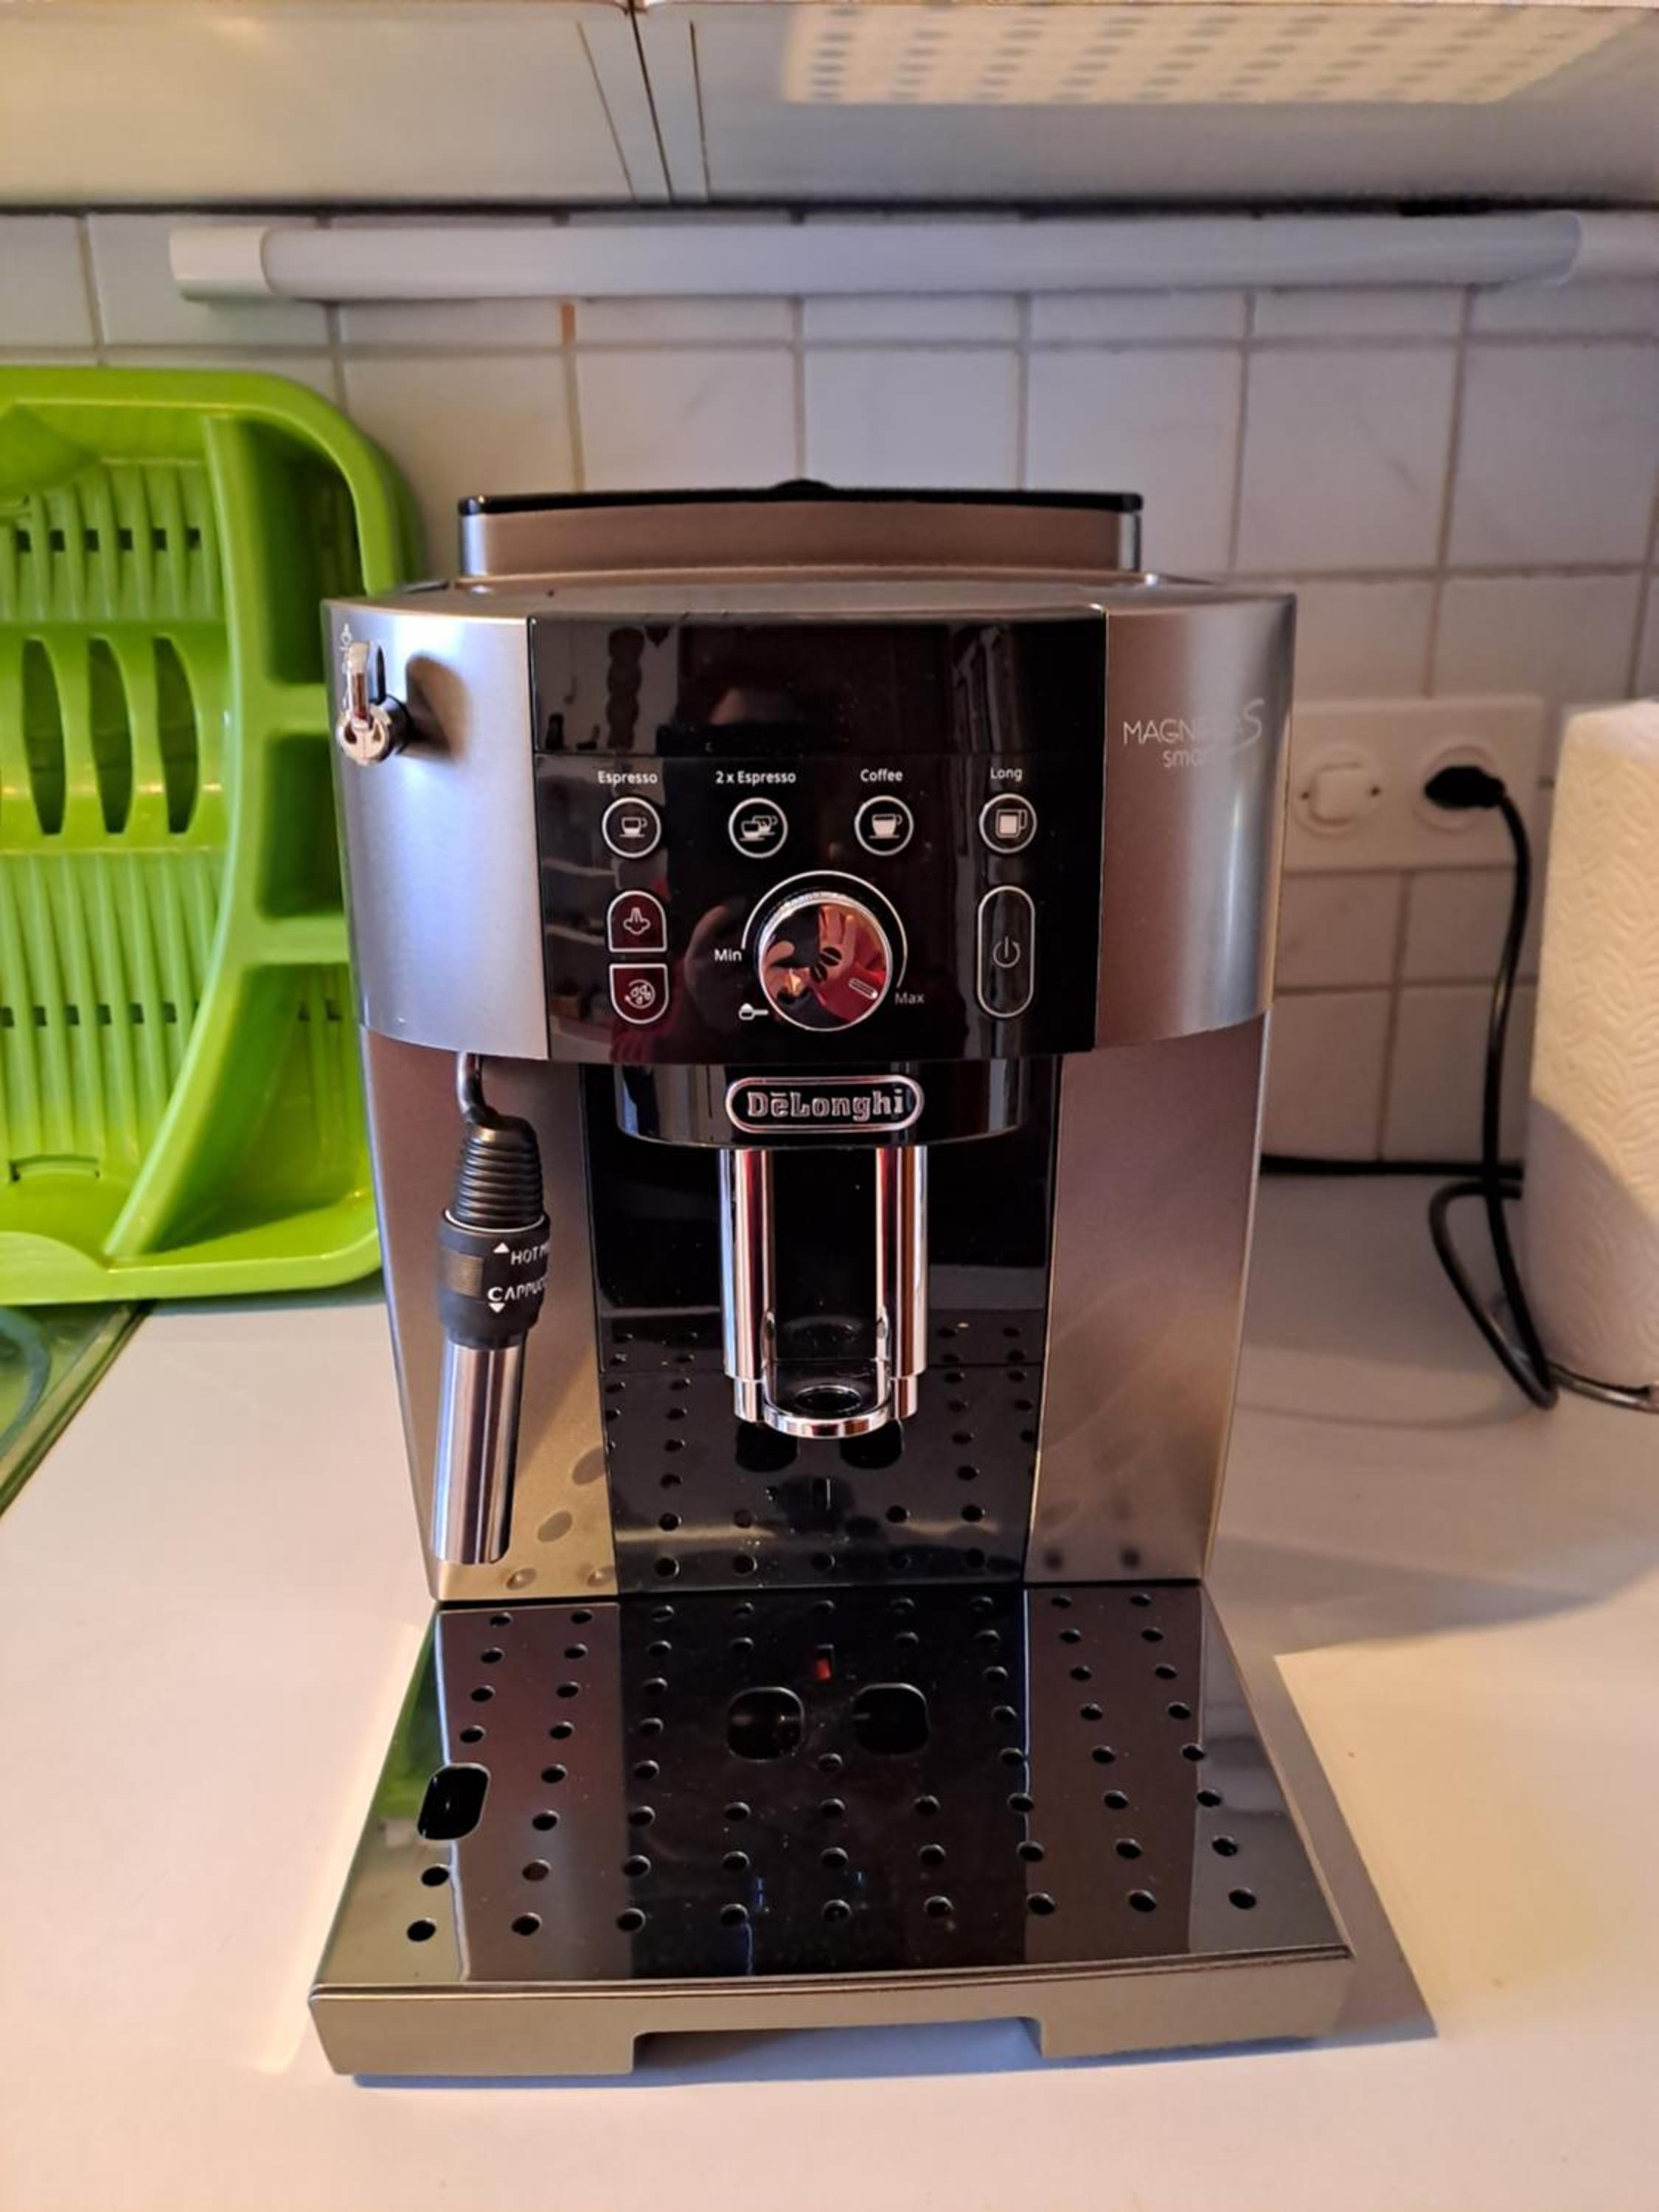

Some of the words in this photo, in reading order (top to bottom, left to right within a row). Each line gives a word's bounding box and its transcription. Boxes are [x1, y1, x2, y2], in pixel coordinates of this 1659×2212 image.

[598, 771, 658, 787] Espresso
[715, 771, 724, 784] 2
[726, 773, 734, 784] x
[737, 771, 797, 787] Espresso
[860, 768, 903, 782] Coffee
[990, 768, 1023, 782] Long
[714, 948, 742, 961] Min
[894, 992, 925, 1005] Max
